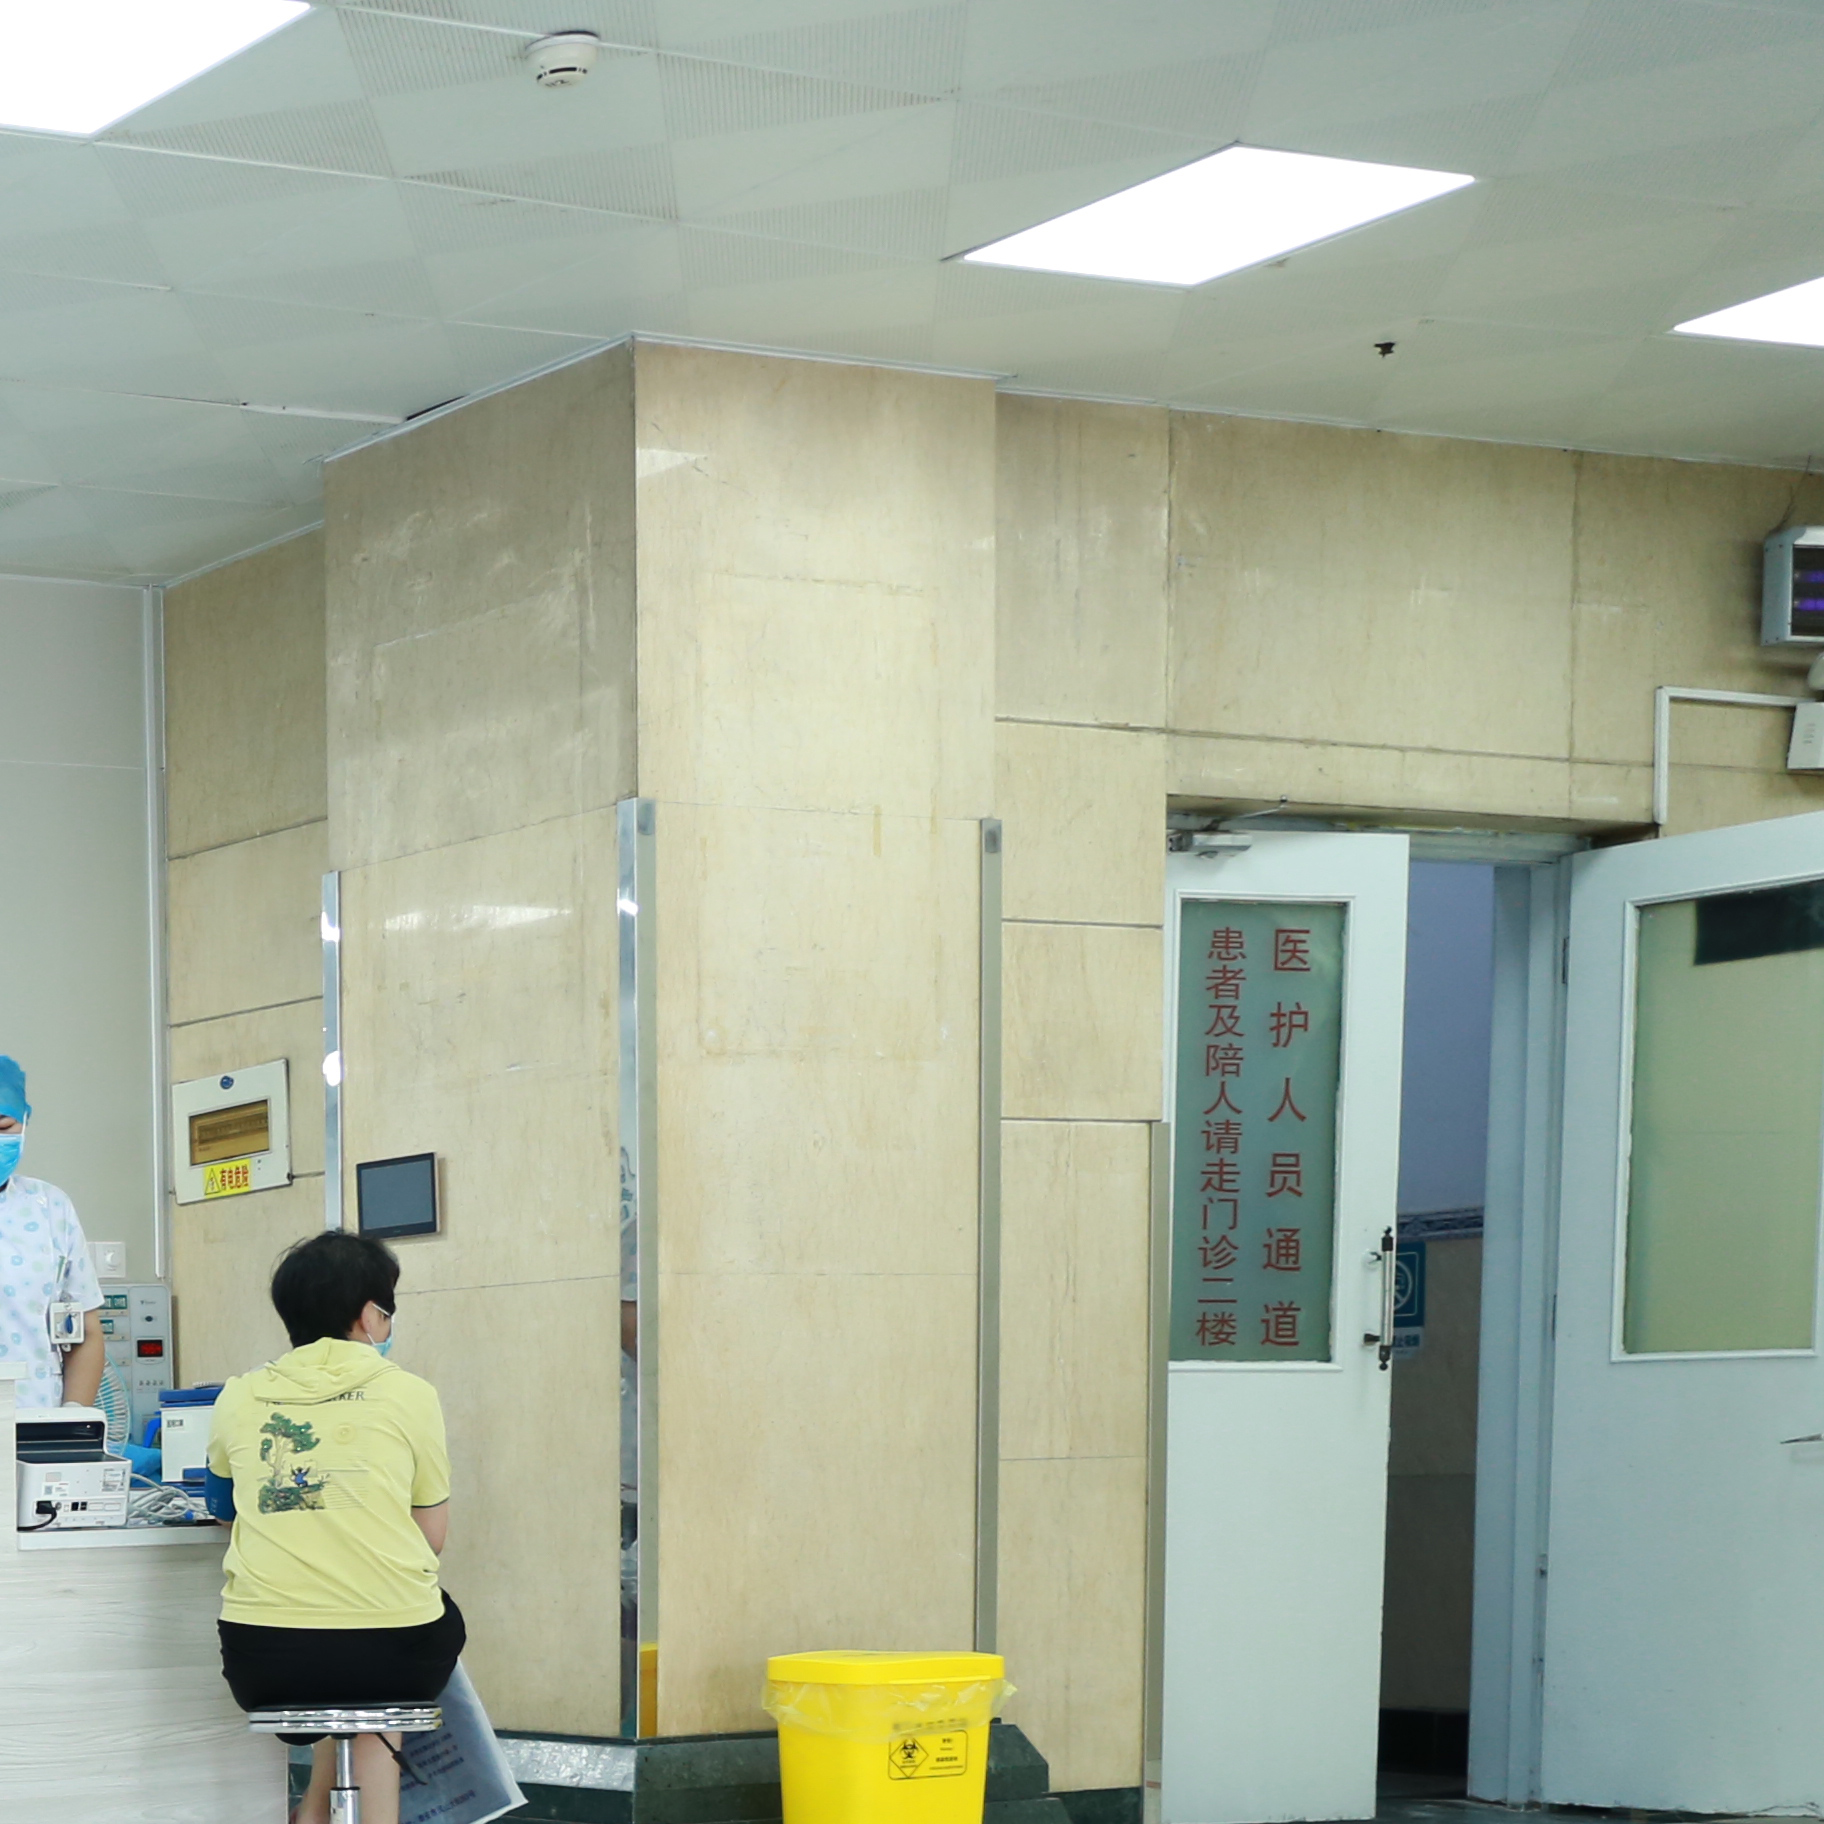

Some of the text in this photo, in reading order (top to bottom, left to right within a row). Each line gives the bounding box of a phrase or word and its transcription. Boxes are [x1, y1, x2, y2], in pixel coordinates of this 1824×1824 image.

[1195, 925, 1247, 1348] 患者及陪人请走门诊二楼
[1260, 927, 1313, 1349] 医护人员通道
